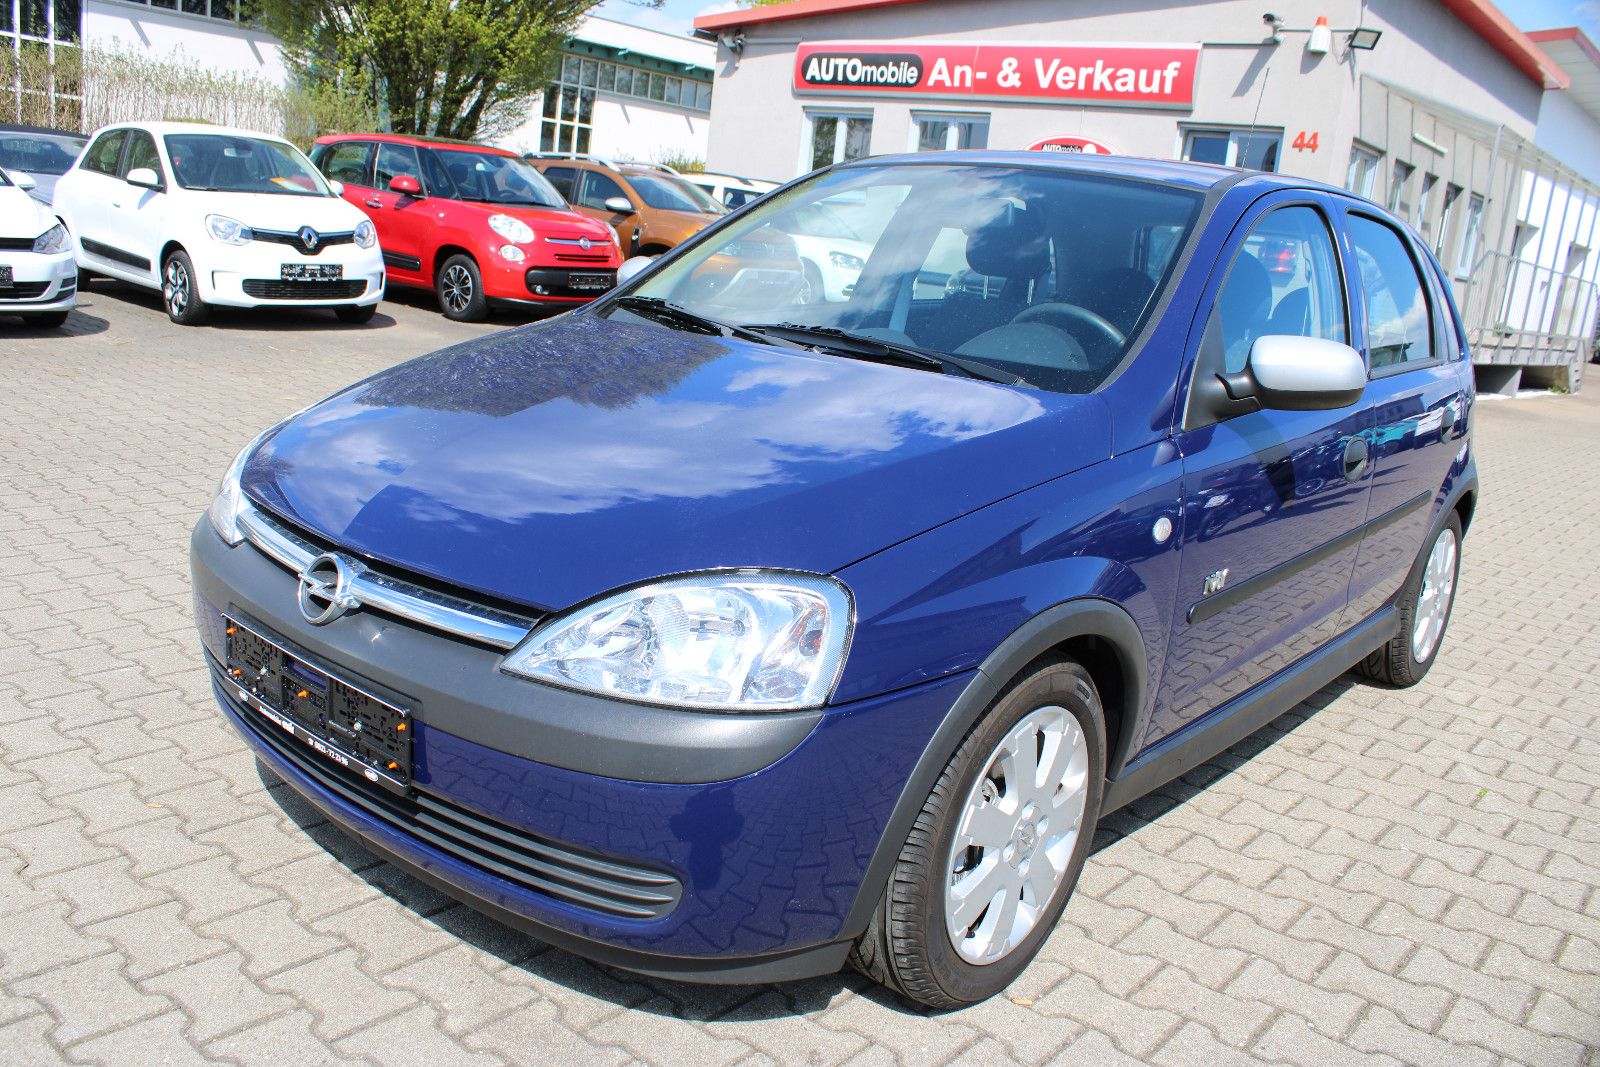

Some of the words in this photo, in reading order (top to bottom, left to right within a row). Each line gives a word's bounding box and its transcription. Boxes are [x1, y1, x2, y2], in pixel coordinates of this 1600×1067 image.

[805, 57, 918, 85] AUTOmobile
[927, 57, 987, 88] An-
[996, 56, 1022, 88] &
[1034, 57, 1181, 95] Verkauf
[1292, 130, 1319, 153] 44
